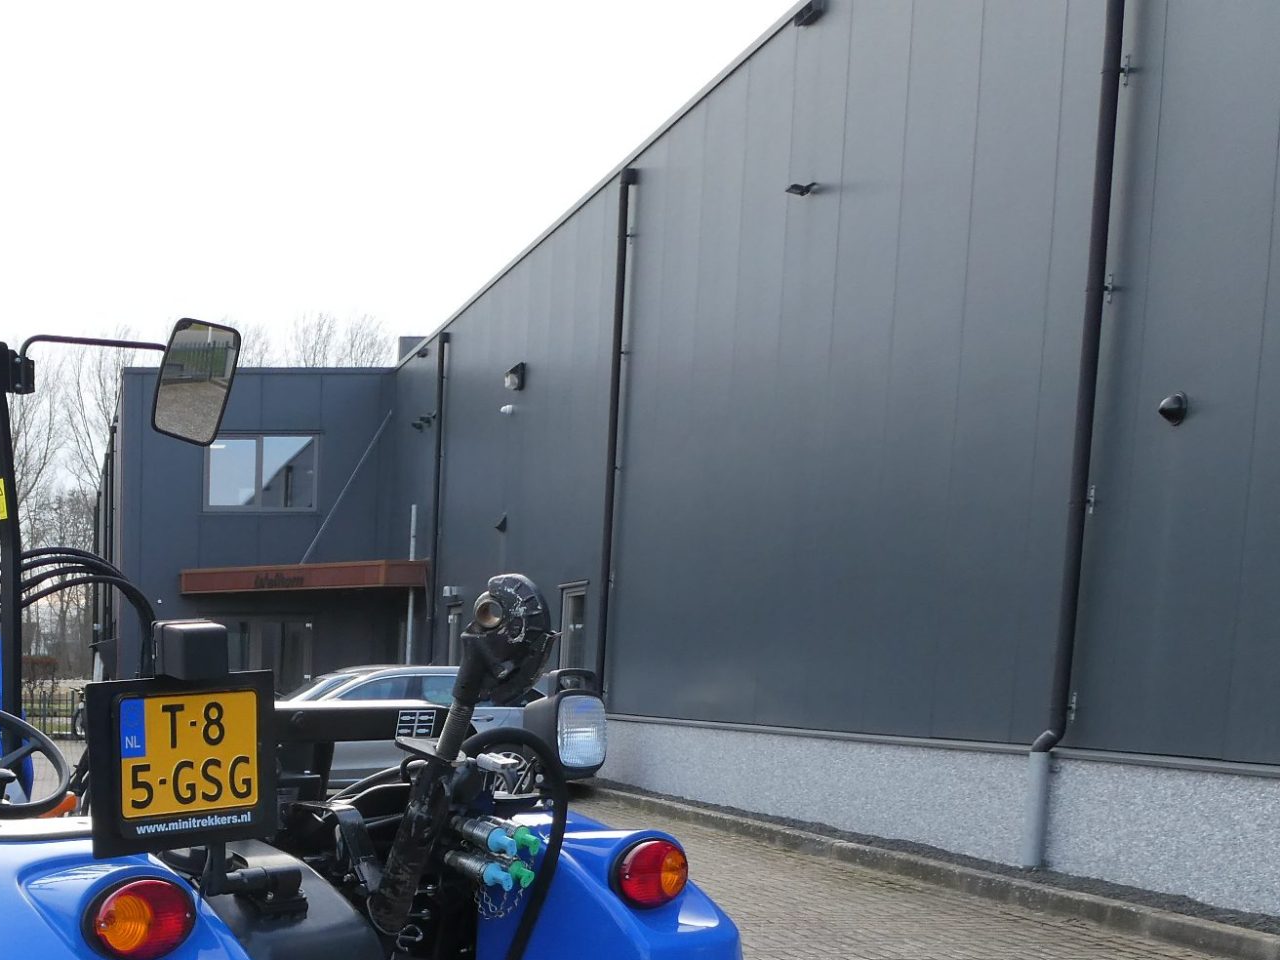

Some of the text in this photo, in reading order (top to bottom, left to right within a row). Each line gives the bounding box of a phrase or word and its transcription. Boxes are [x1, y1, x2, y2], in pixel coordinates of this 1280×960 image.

[125, 735, 141, 749] NL
[161, 702, 225, 749] T-8
[131, 755, 252, 809] 5-GSG
[136, 811, 252, 835] www.minitrekkers.nl
